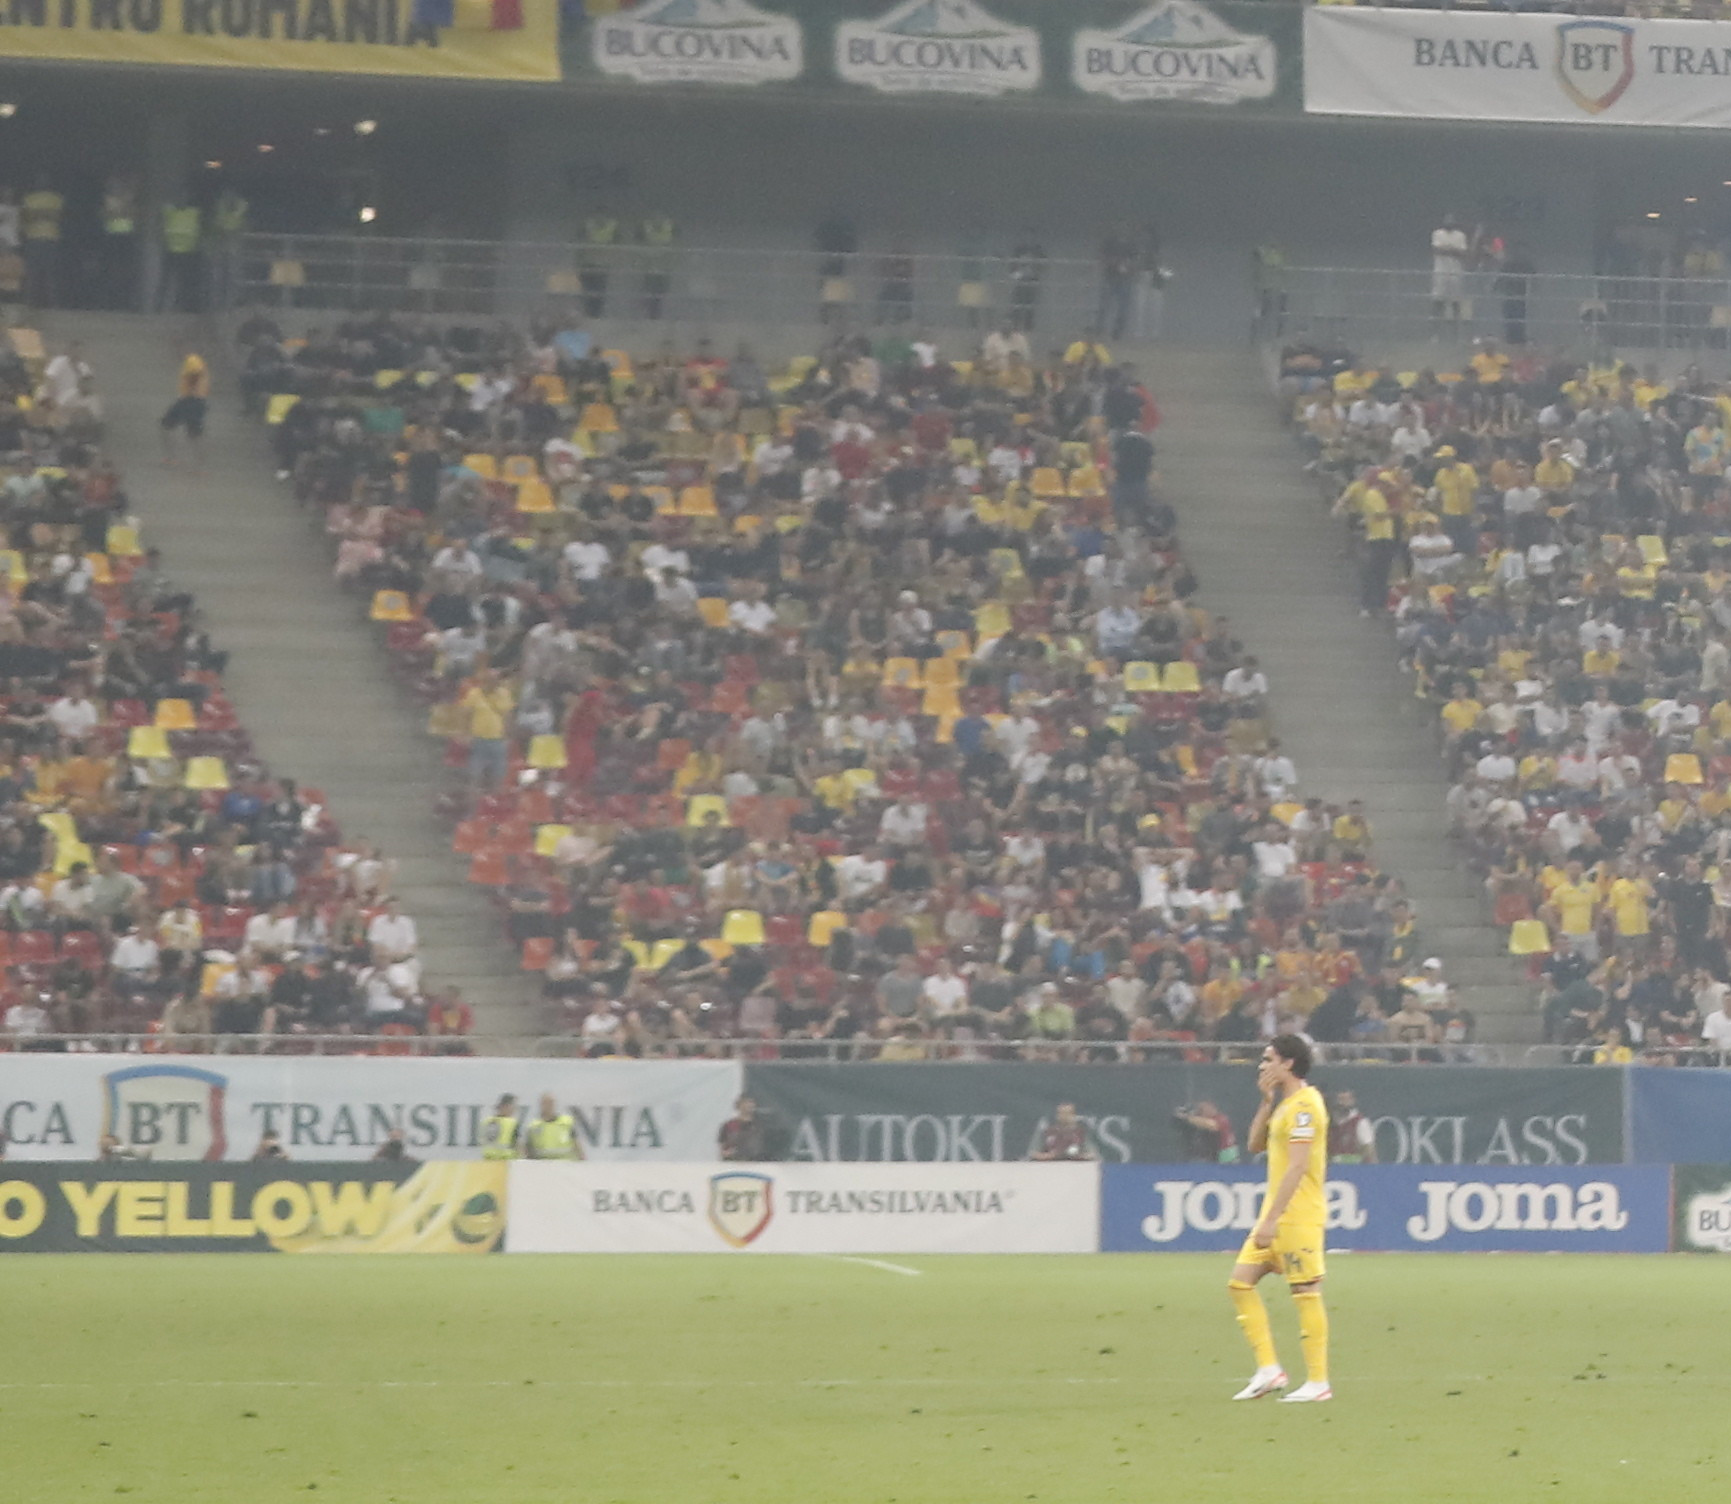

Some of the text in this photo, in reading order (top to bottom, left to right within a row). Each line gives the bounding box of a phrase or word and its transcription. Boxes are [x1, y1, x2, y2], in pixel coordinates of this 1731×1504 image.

[605, 28, 791, 62] BUCOVINA
[848, 37, 1028, 71] BUCOVINA
[1413, 37, 1540, 71] BANCA
[1571, 43, 1619, 73] BT
[1086, 47, 1265, 81] BUCOVINA
[128, 1100, 203, 1146] BT
[251, 1101, 665, 1149] TRANSILNIA
[58, 1180, 398, 1238] YELLOW
[591, 1189, 1005, 1215] BANCA BT TRANSILVANIA
